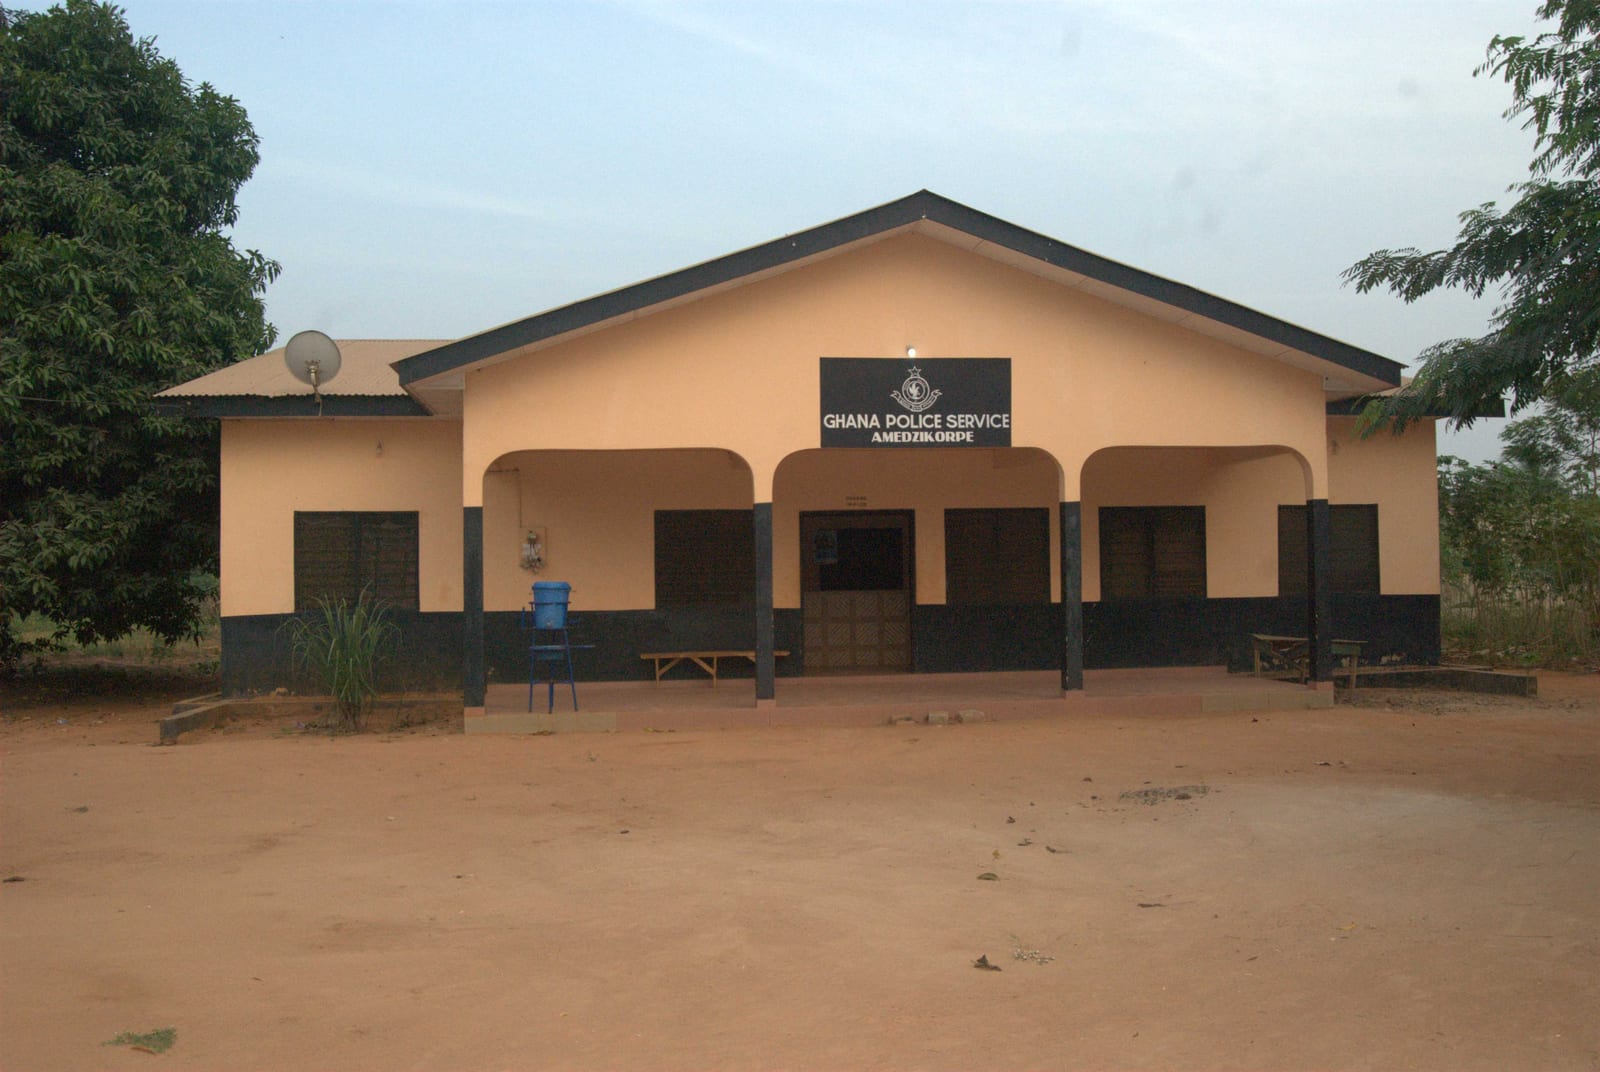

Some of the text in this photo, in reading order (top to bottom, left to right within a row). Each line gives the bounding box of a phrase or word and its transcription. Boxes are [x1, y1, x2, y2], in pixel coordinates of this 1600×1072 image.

[823, 414, 1010, 429] GHANA POLICE SERVICE
[871, 431, 974, 442] AMEDZIKORPE
